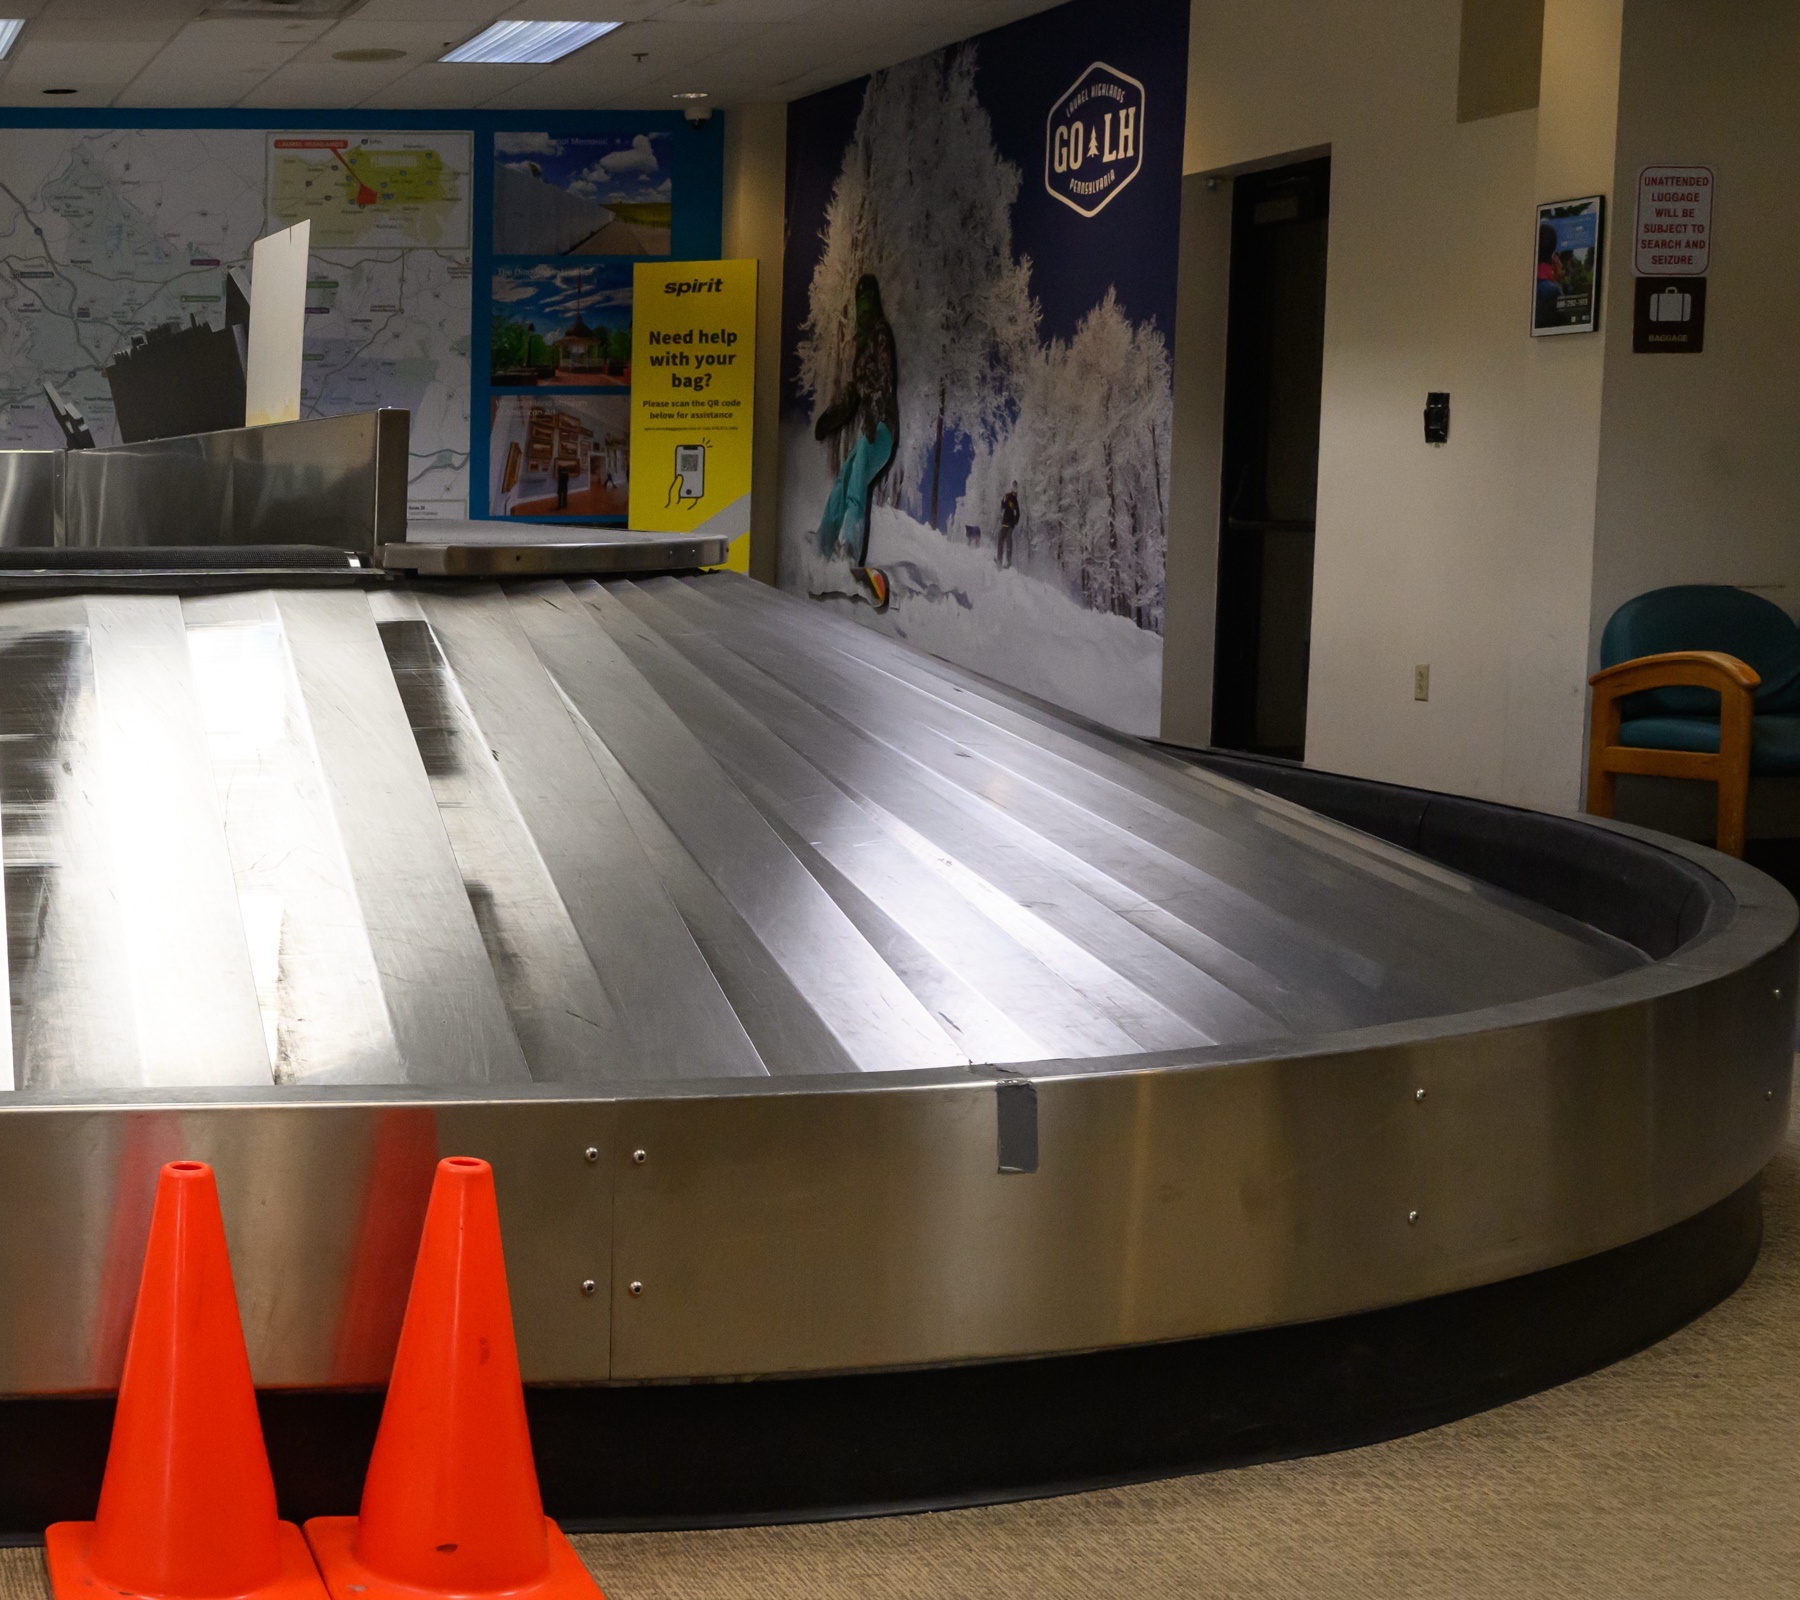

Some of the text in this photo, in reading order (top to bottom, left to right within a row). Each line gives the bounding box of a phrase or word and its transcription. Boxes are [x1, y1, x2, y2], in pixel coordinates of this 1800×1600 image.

[1066, 83, 1126, 118] LAUREL HIGHLANDS
[1054, 106, 1136, 174] GO LH
[1069, 168, 1116, 195] PENNSYLVANIA
[1644, 176, 1709, 187] UNATTENDED
[1651, 192, 1700, 202] LUGGAGE
[1655, 208, 1695, 218] WILL BE
[1643, 223, 1705, 234] SUBJECT TO
[1641, 239, 1706, 249] SEARCH AND
[1651, 255, 1693, 265] SEIZURE
[664, 278, 724, 297] spirit
[649, 328, 738, 347] Need help
[1648, 334, 1688, 342] BAGGAGE
[650, 351, 736, 370] with your
[671, 373, 712, 391] bag?
[691, 399, 705, 407] the
[707, 399, 719, 408] QR
[721, 399, 741, 407] code
[649, 411, 733, 419] below for assistance
